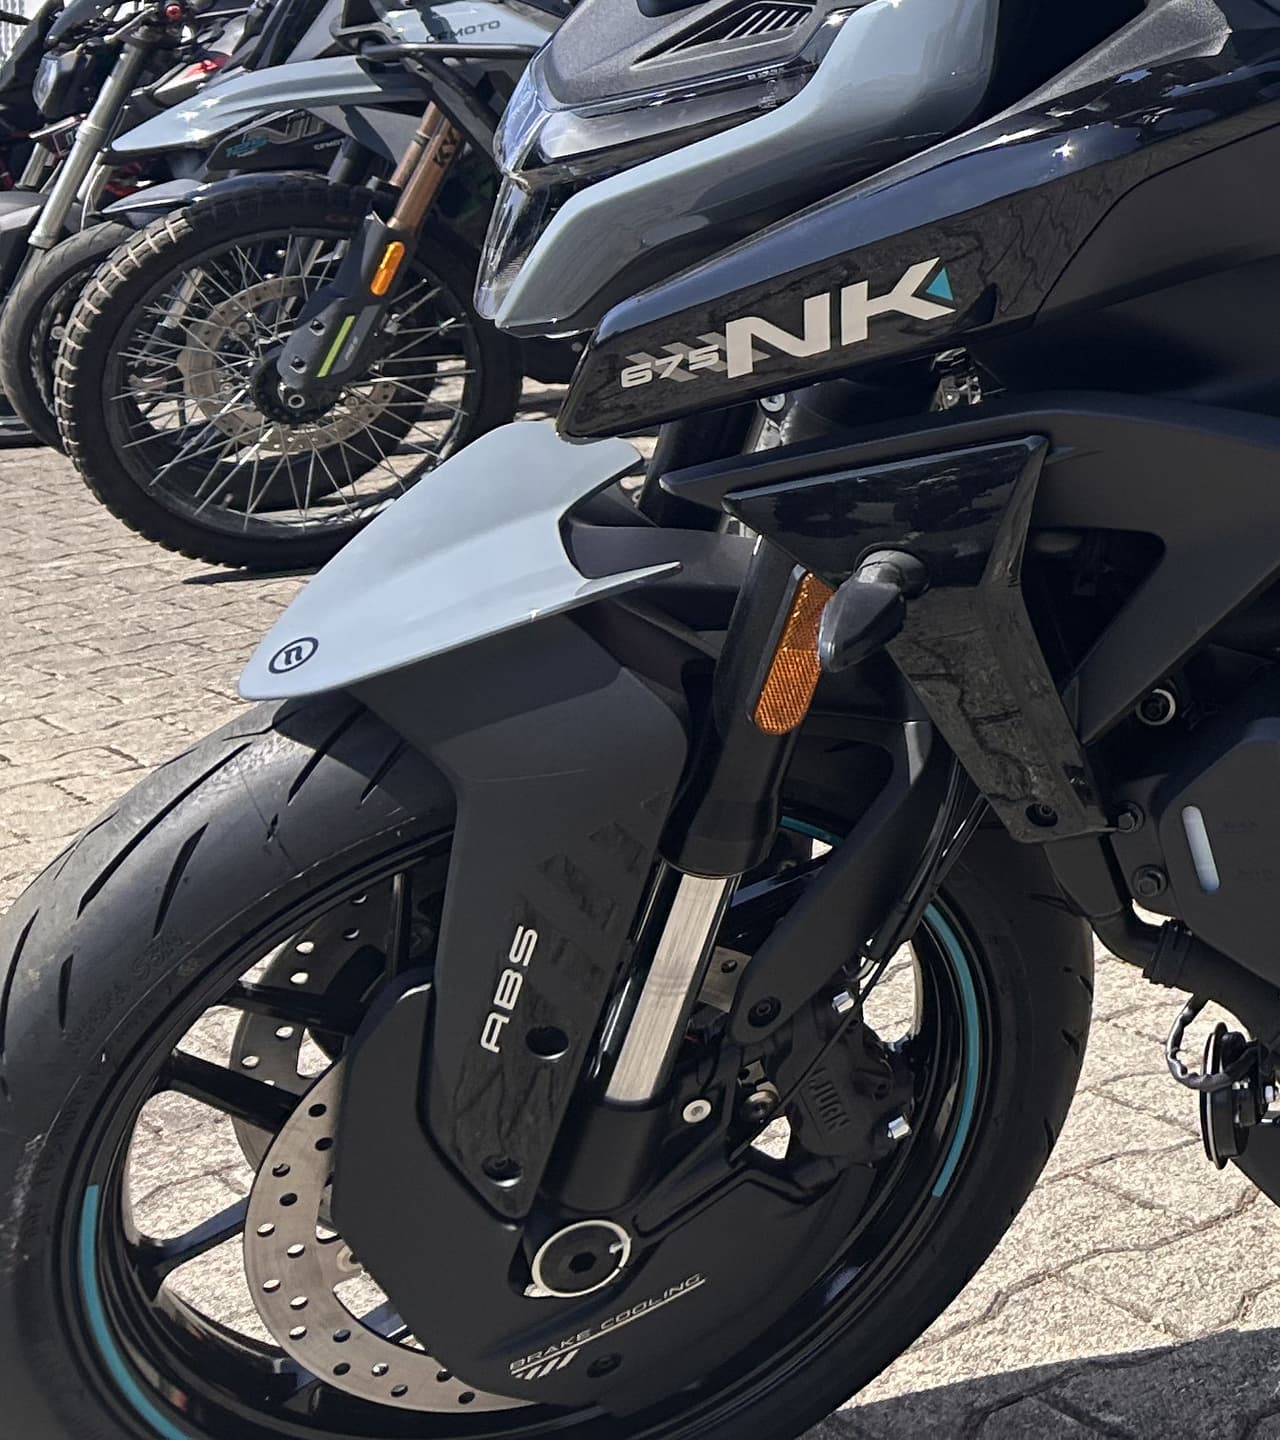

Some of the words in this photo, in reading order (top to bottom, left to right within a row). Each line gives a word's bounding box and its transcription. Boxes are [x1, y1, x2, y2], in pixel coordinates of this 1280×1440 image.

[620, 344, 721, 389] 675
[725, 257, 956, 379] NK
[480, 925, 538, 1053] ABS
[509, 1328, 592, 1371] BRAKE
[600, 1273, 701, 1331] COOLING
